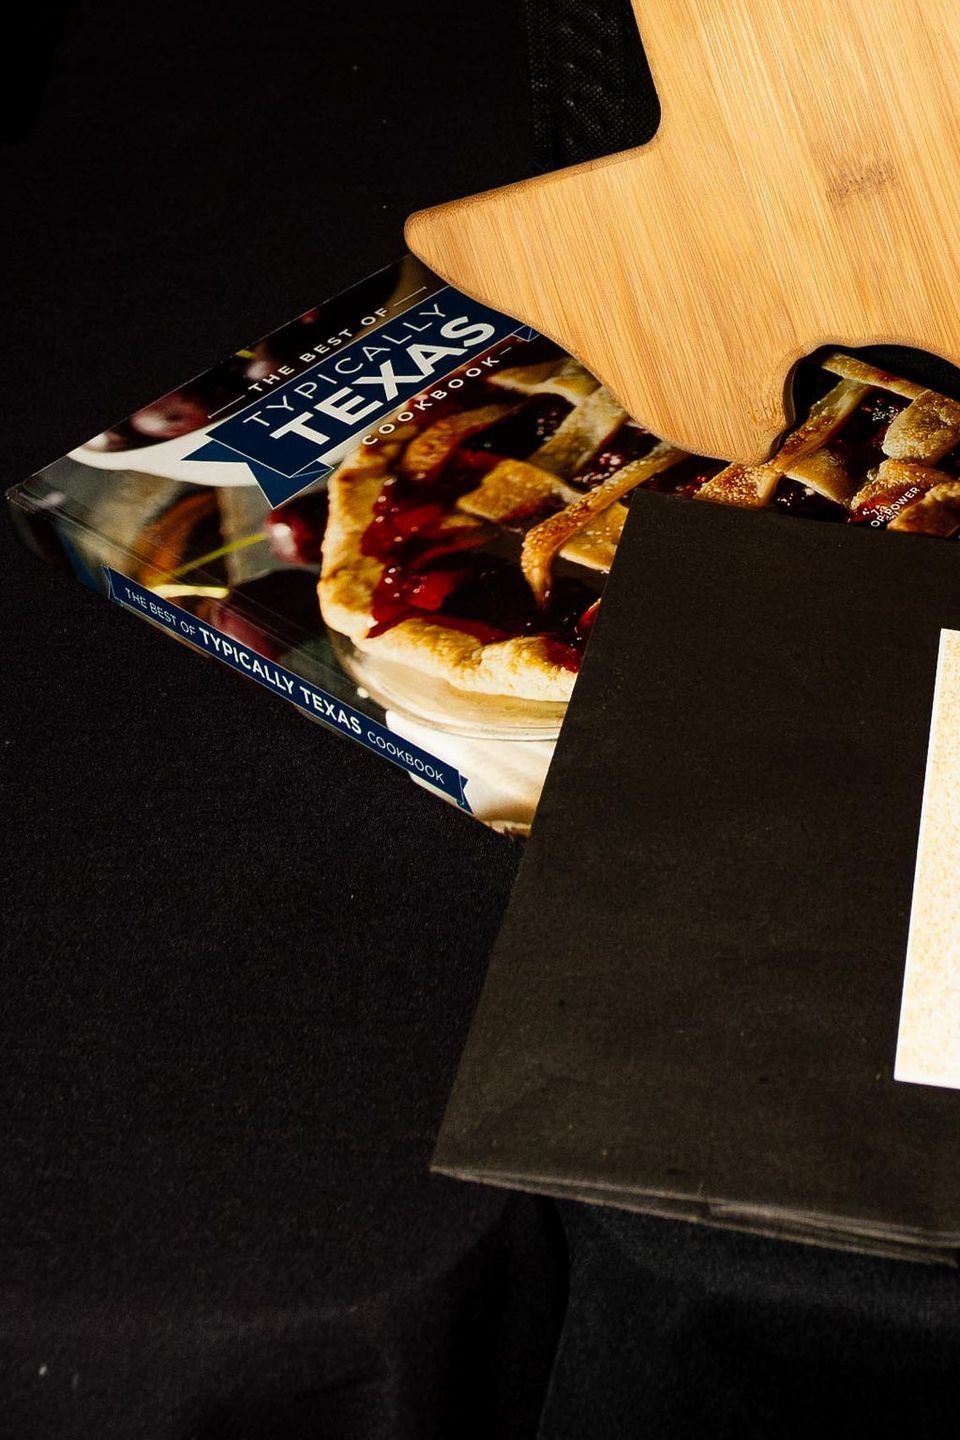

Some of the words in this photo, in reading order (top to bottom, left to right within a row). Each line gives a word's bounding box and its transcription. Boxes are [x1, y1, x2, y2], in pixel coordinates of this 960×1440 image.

[242, 303, 447, 428] TYPICALLY
[248, 365, 295, 394] THE
[299, 328, 353, 363] BEST
[360, 307, 389, 326] OF
[269, 315, 496, 446] TEXAS
[361, 356, 500, 447] COOKBOOK
[884, 486, 921, 516] POWER
[125, 587, 148, 610] THE
[149, 602, 177, 623] BEST
[180, 620, 196, 636] OF
[199, 626, 295, 695] TYPICALLY
[299, 685, 362, 735] TEXAS
[367, 730, 446, 785] COOKBOOK
